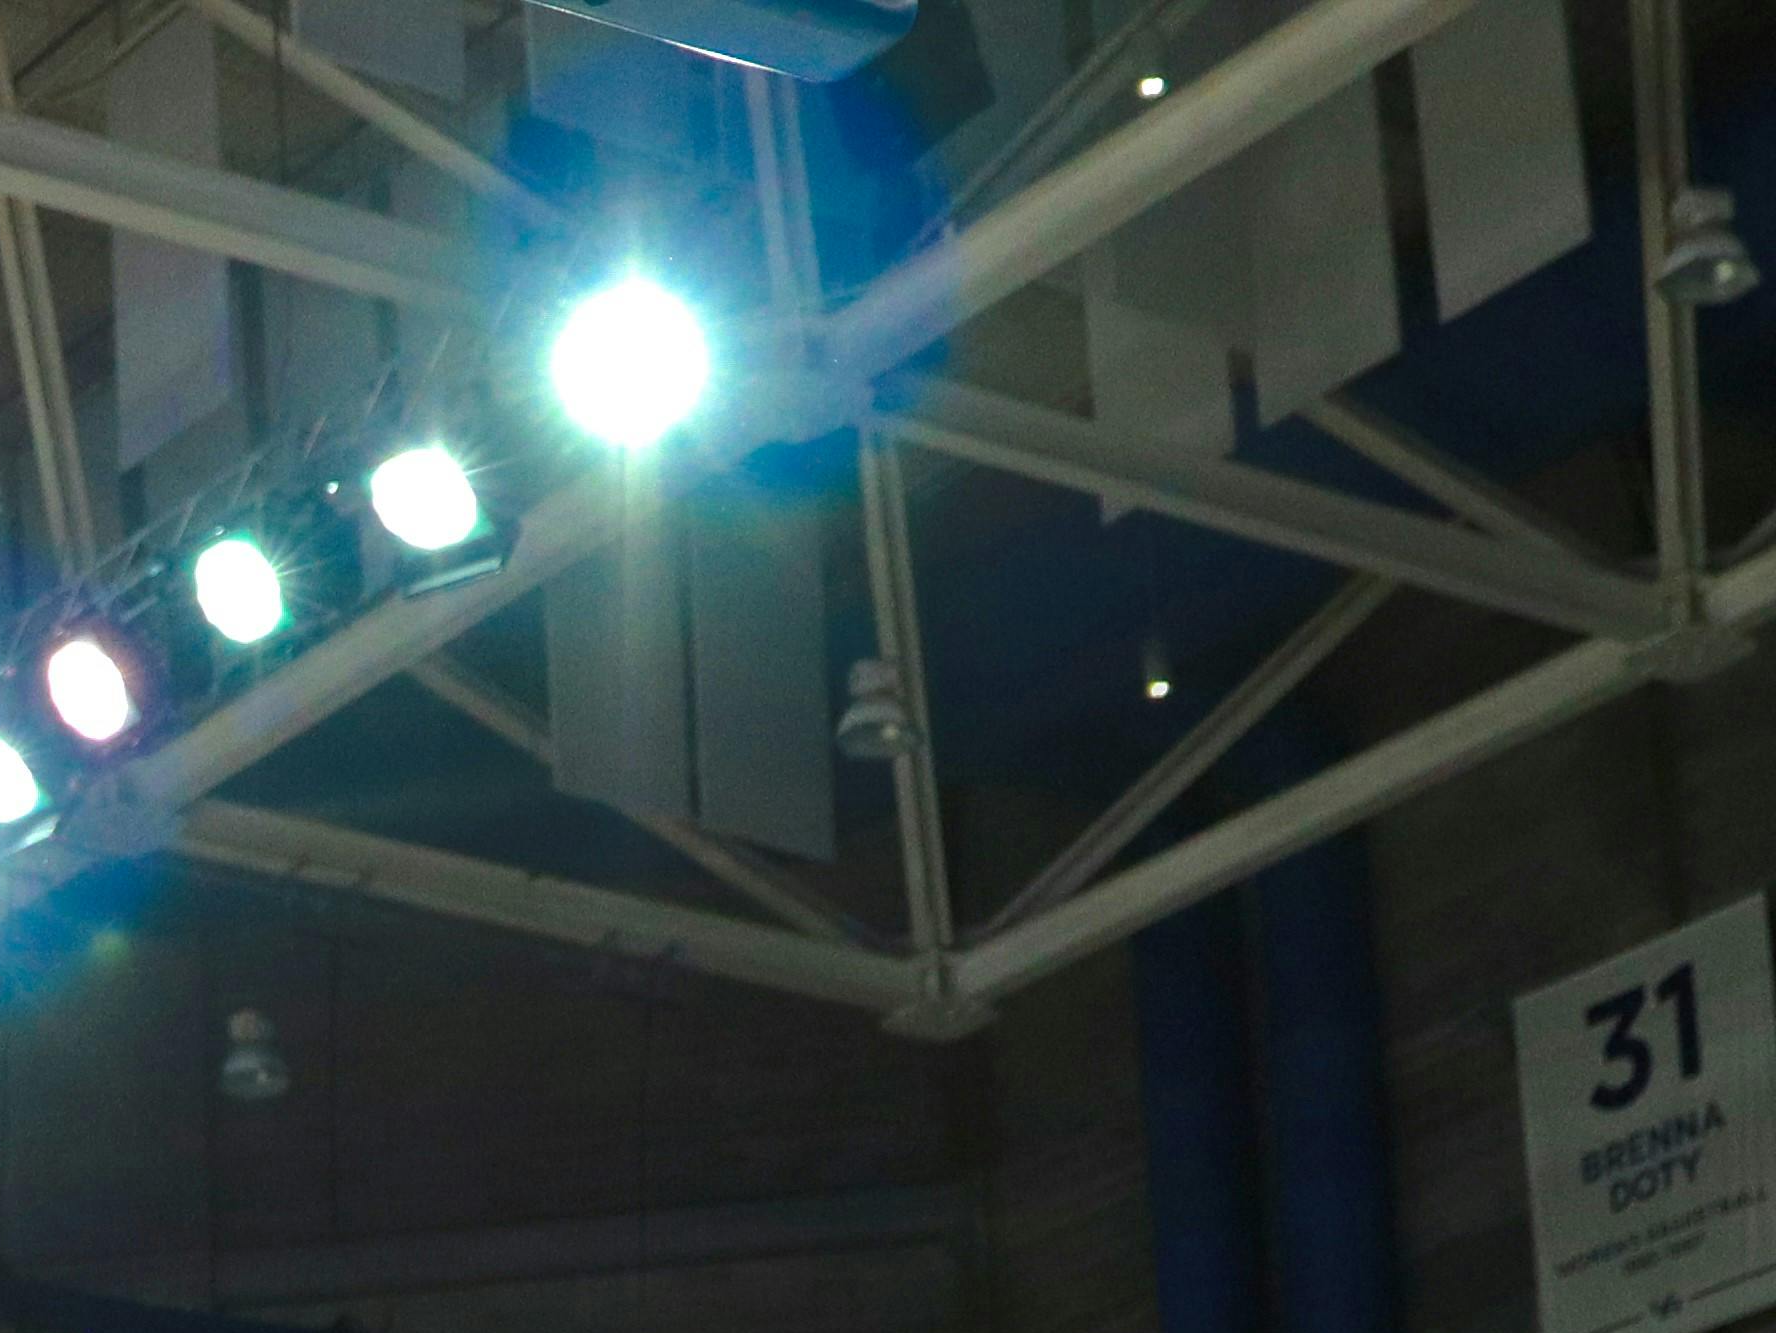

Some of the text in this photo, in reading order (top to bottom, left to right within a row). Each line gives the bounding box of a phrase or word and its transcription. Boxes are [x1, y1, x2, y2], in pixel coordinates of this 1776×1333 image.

[1585, 960, 1703, 1114] 31
[1580, 1100, 1728, 1186] BRENNA
[1609, 1148, 1702, 1214] DOTY
